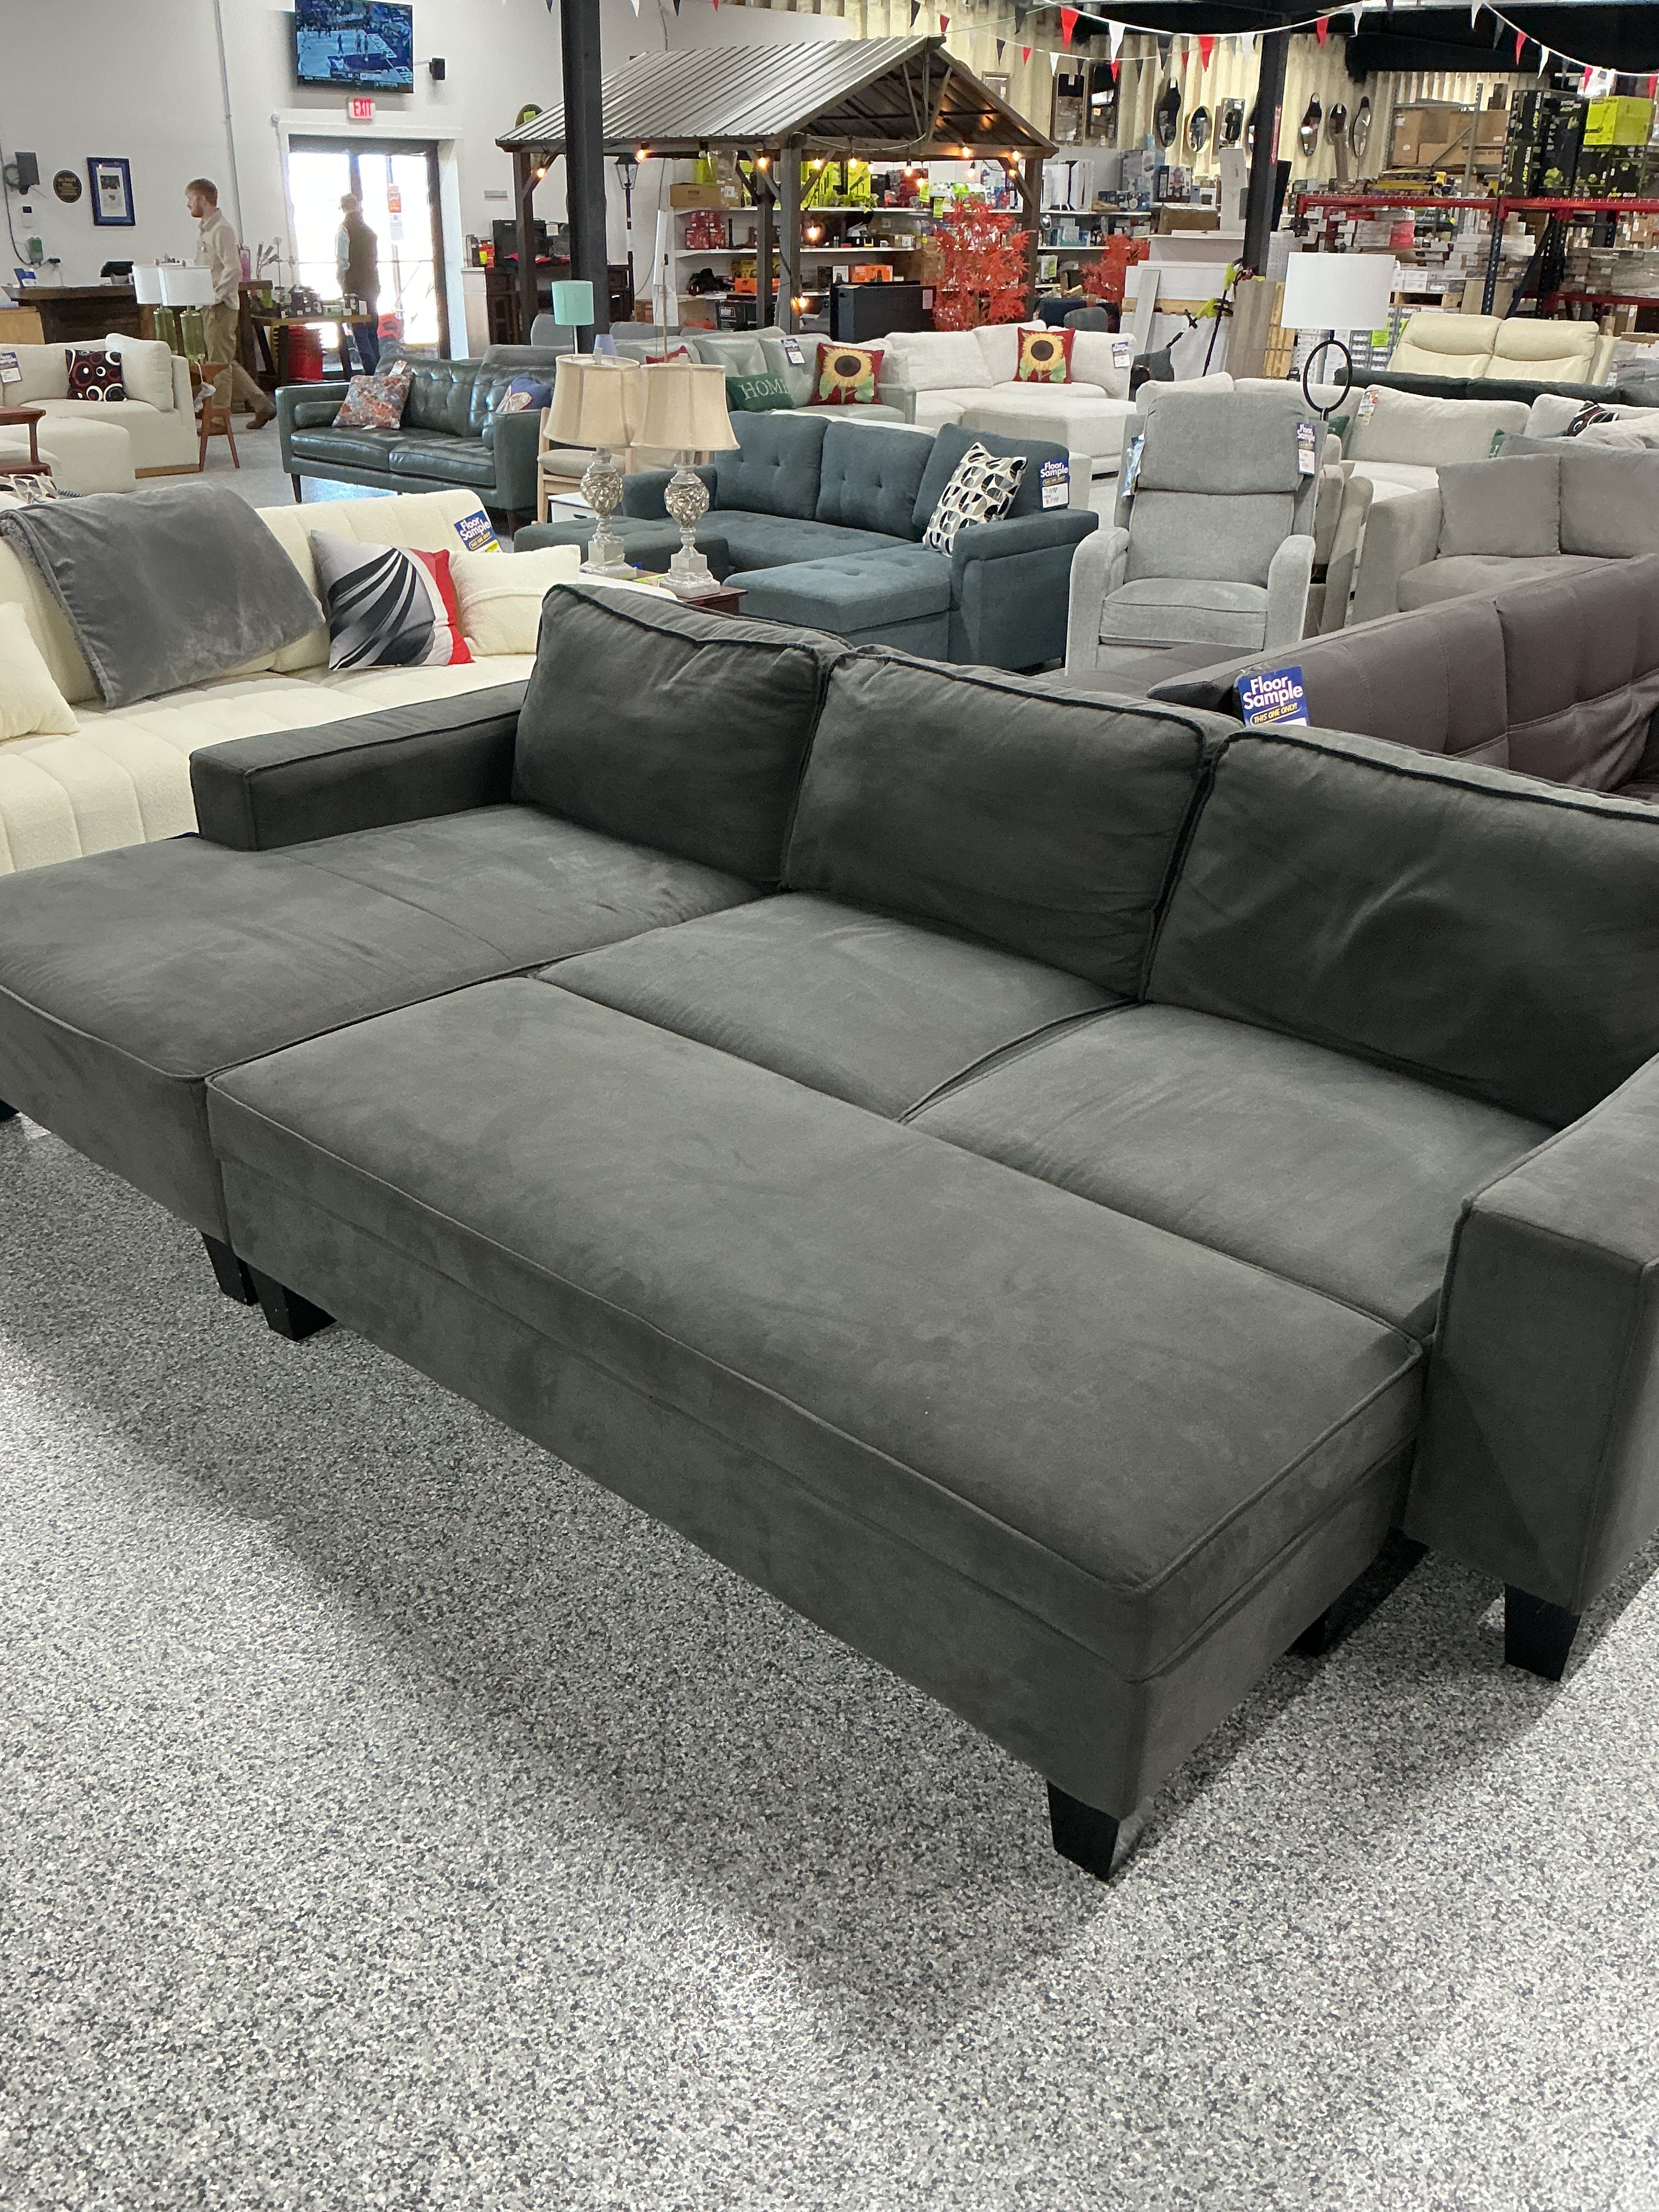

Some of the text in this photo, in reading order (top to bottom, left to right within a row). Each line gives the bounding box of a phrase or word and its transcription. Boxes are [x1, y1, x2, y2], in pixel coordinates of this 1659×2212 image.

[353, 98, 371, 117] EXIT
[1297, 430, 1316, 443] Sample
[1300, 424, 1313, 433] Floor
[1040, 465, 1069, 478] Sample
[1045, 461, 1063, 471] Floor
[460, 517, 480, 532] Floor
[460, 519, 490, 540] Sample
[1250, 675, 1288, 695] Floor
[1243, 680, 1304, 710] Sample
[1253, 702, 1298, 724] THIS ONE ONLY!
